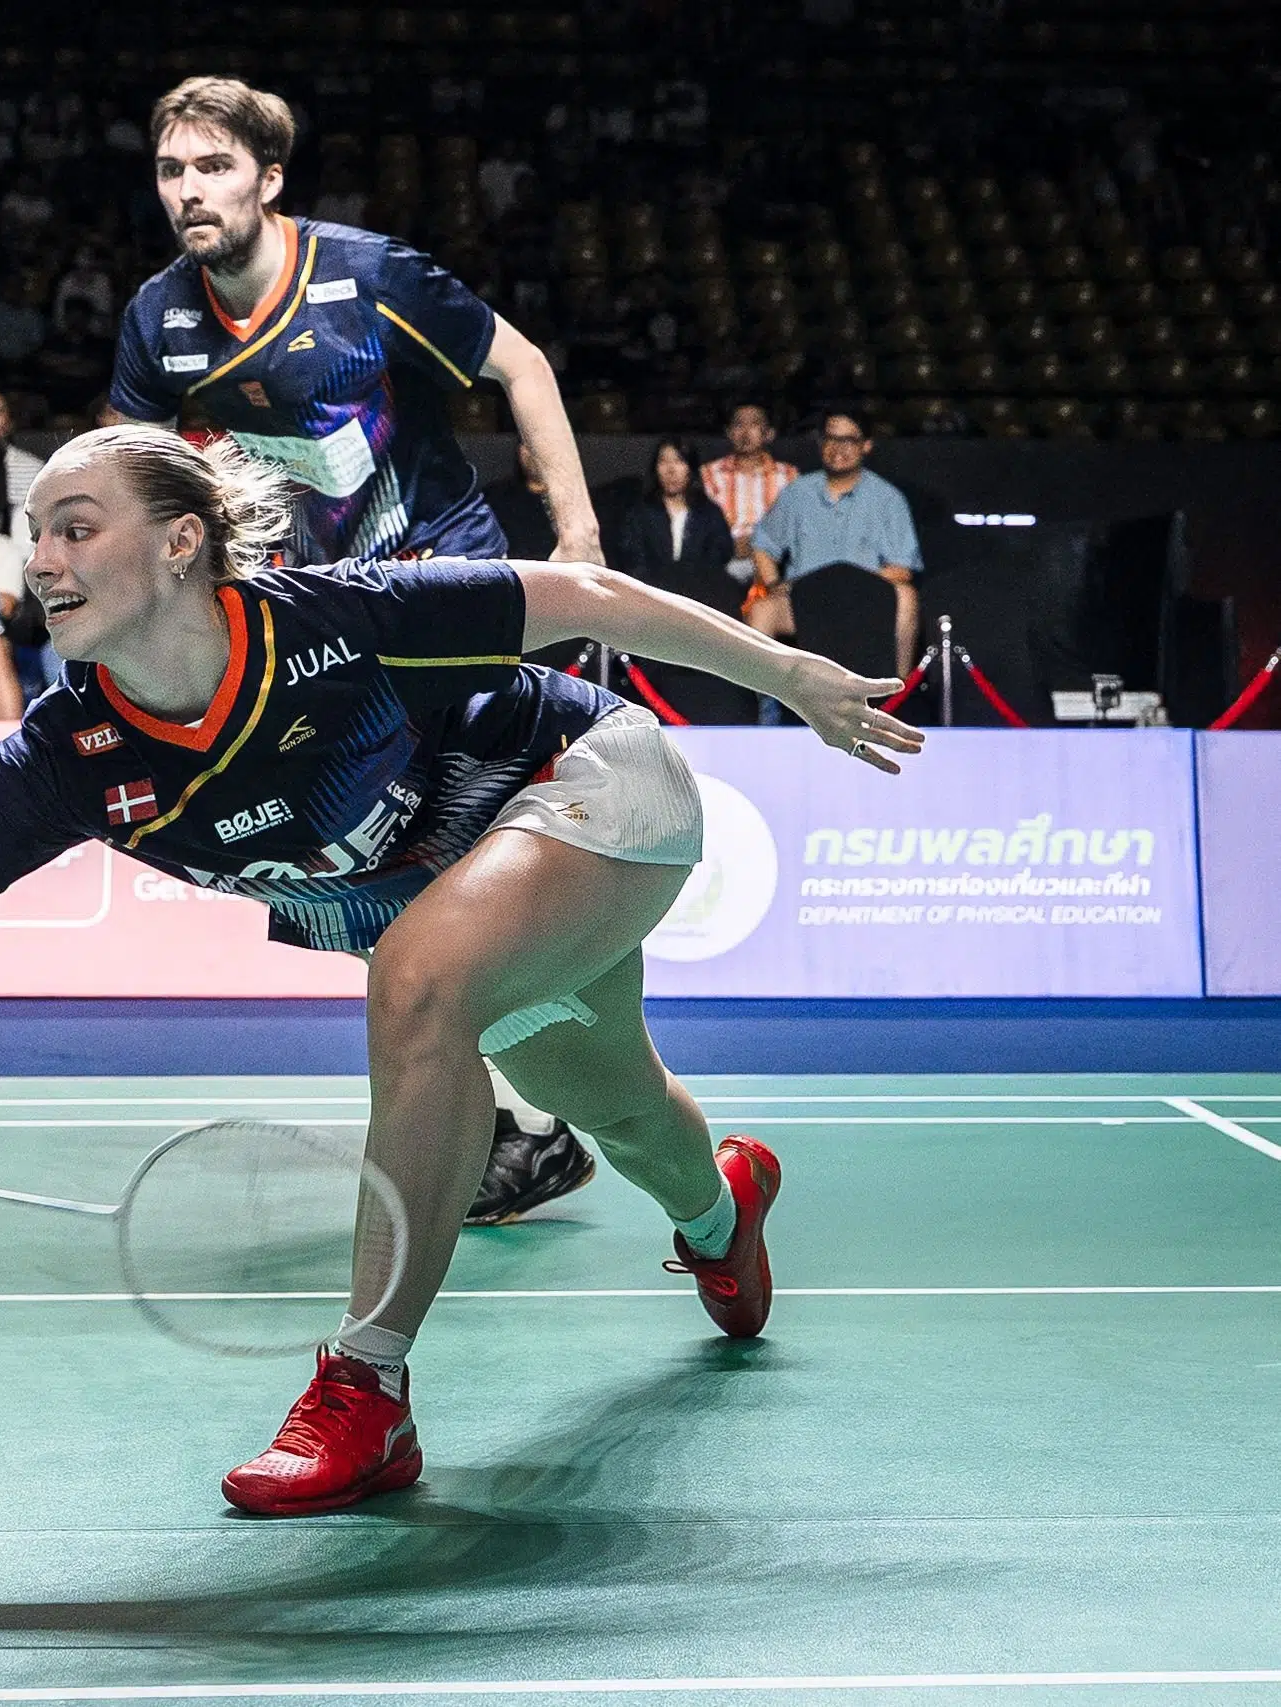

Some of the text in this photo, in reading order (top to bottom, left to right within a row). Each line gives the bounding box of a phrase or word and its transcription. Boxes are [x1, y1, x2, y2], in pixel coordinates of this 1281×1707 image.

[286, 636, 362, 686] JUAL
[278, 728, 317, 753] HUNDRED
[214, 799, 285, 841] BØJE
[802, 812, 1156, 866] กรมพลศึกษา
[134, 870, 189, 902] Get
[798, 904, 1163, 925] DEPARTMENT OF PHYSICAL EDUCATION
